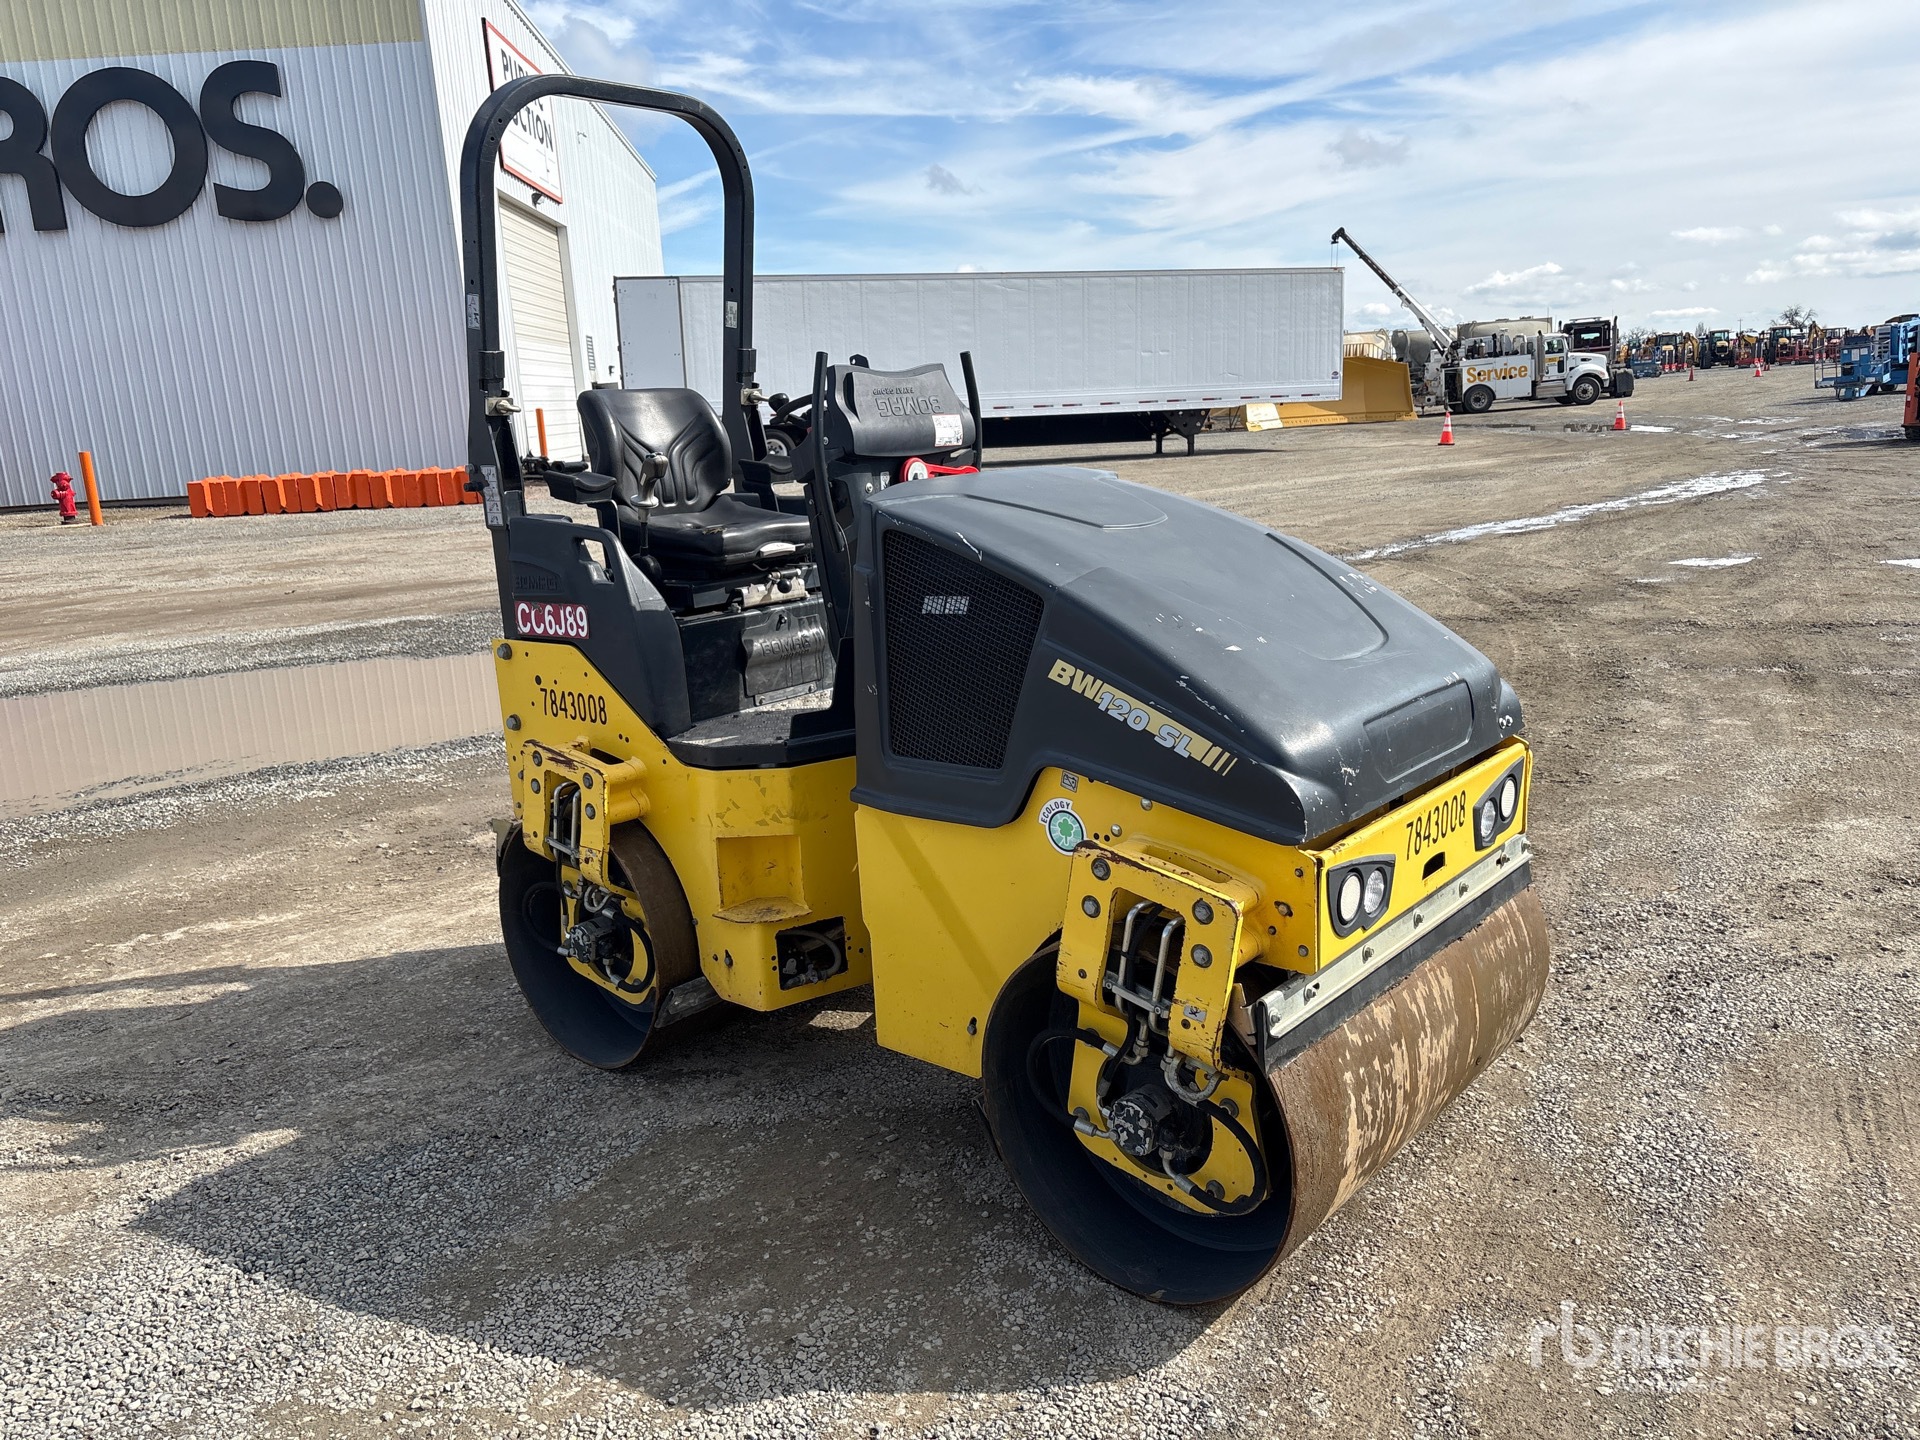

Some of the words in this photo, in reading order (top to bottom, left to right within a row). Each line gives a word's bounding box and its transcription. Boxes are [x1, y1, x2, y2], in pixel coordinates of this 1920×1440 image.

[1466, 362, 1529, 384] Service
[874, 394, 945, 417] BOMAG
[517, 602, 589, 638] CC6J89
[760, 635, 811, 657] BOMAG
[540, 687, 607, 726] 7843008
[1153, 722, 1194, 759] SL
[1040, 800, 1072, 824] ECOLOGY
[1405, 789, 1467, 861] 7843008
